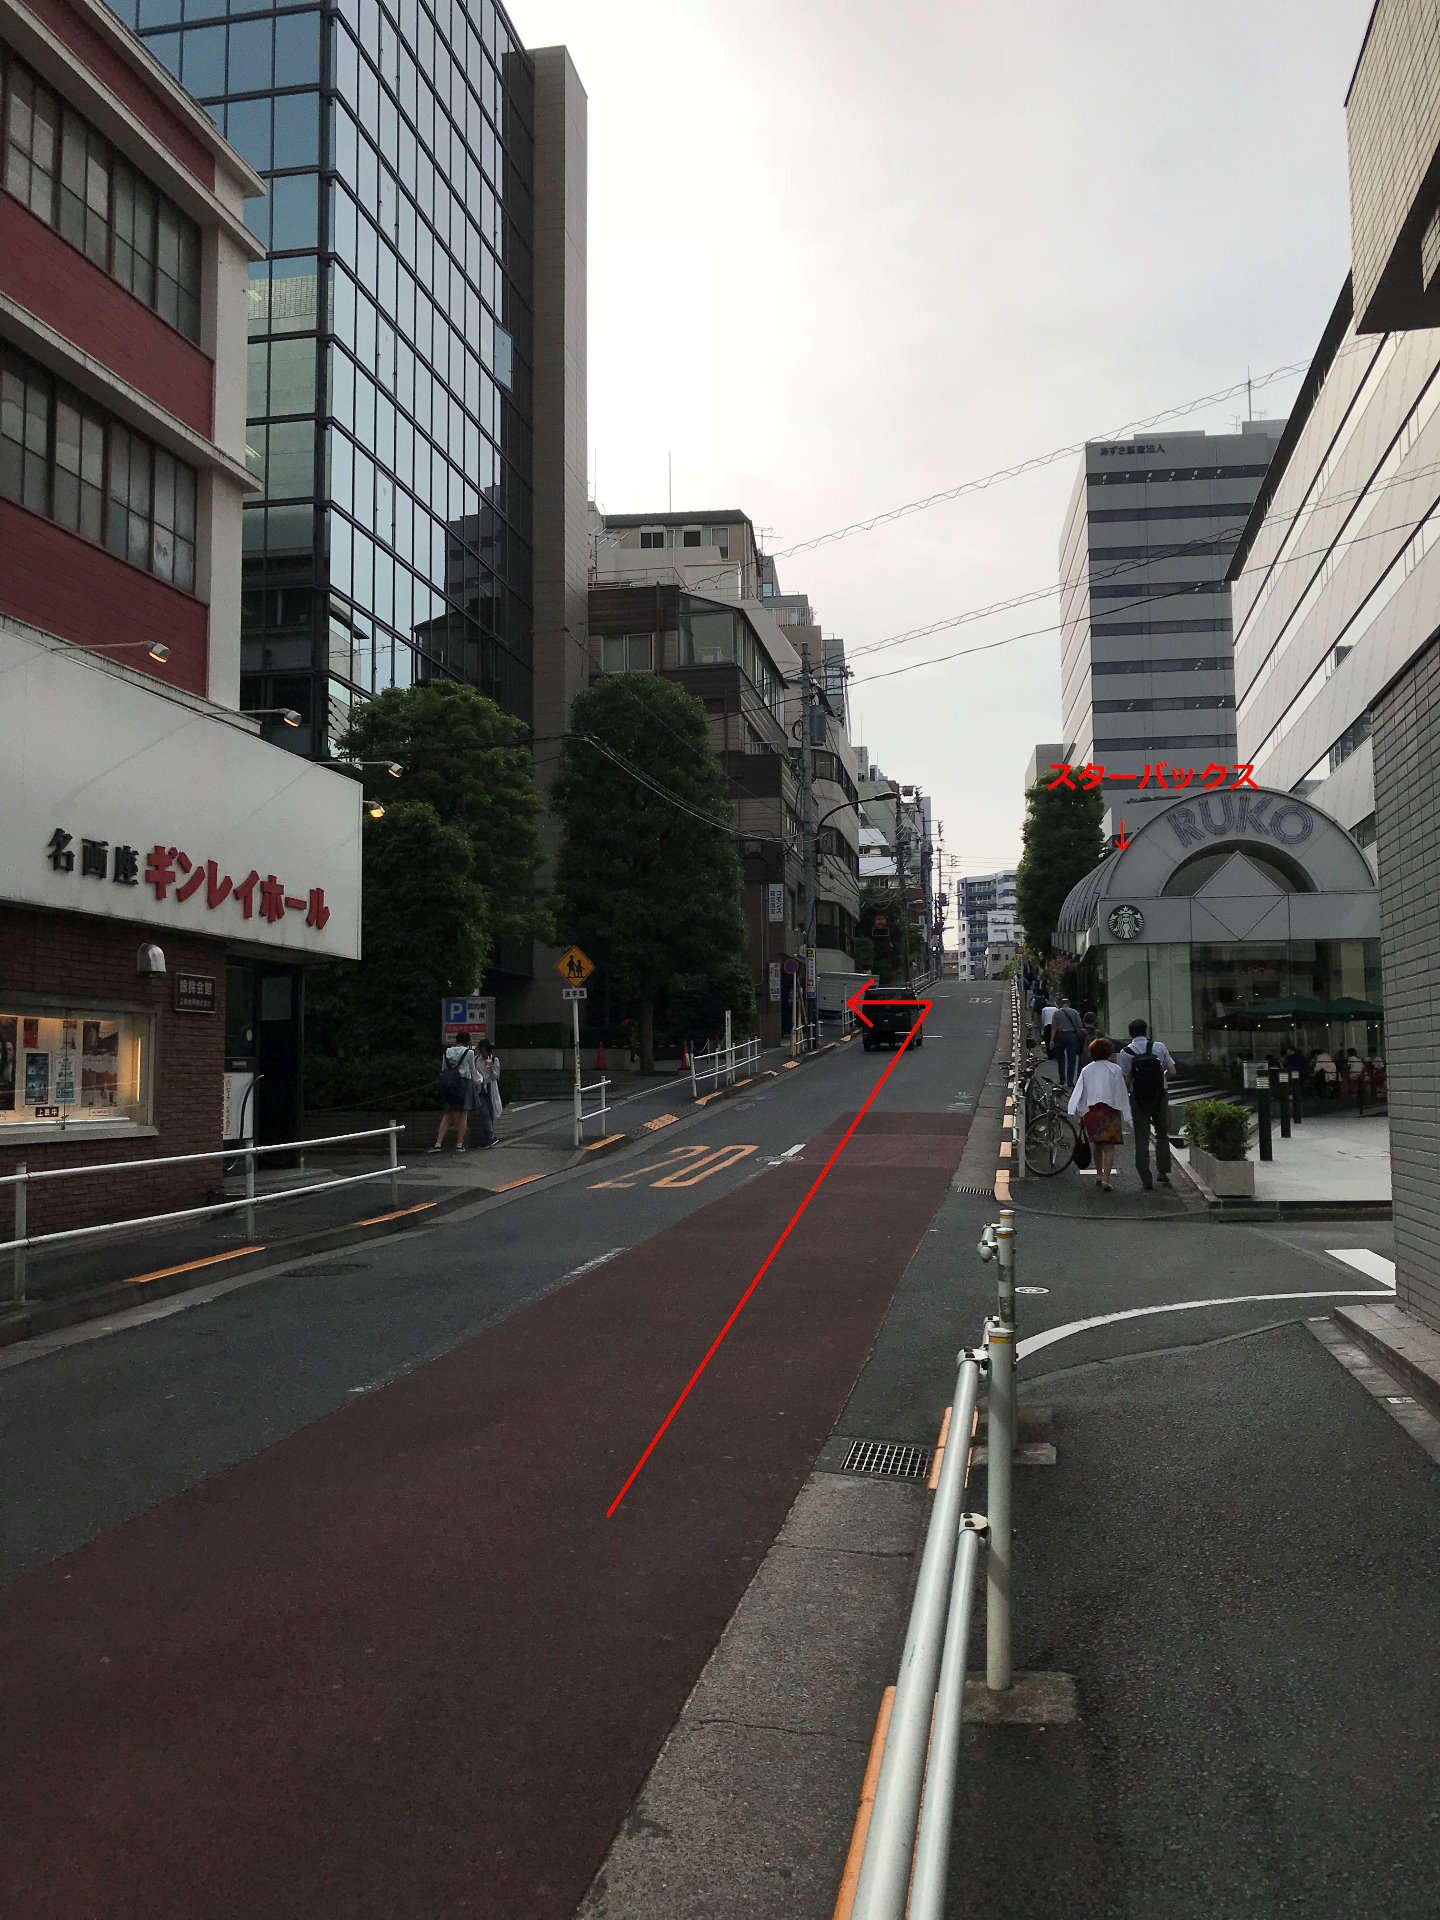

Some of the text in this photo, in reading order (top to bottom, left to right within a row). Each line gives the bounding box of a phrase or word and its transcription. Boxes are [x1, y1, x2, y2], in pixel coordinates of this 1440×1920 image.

[1100, 444, 1165, 456] あずさ監査法人
[1166, 794, 1313, 848] RUKO
[47, 827, 331, 930] 名画座 ギンレイホール
[450, 1003, 463, 1020] P
[586, 1144, 759, 1189] 20
